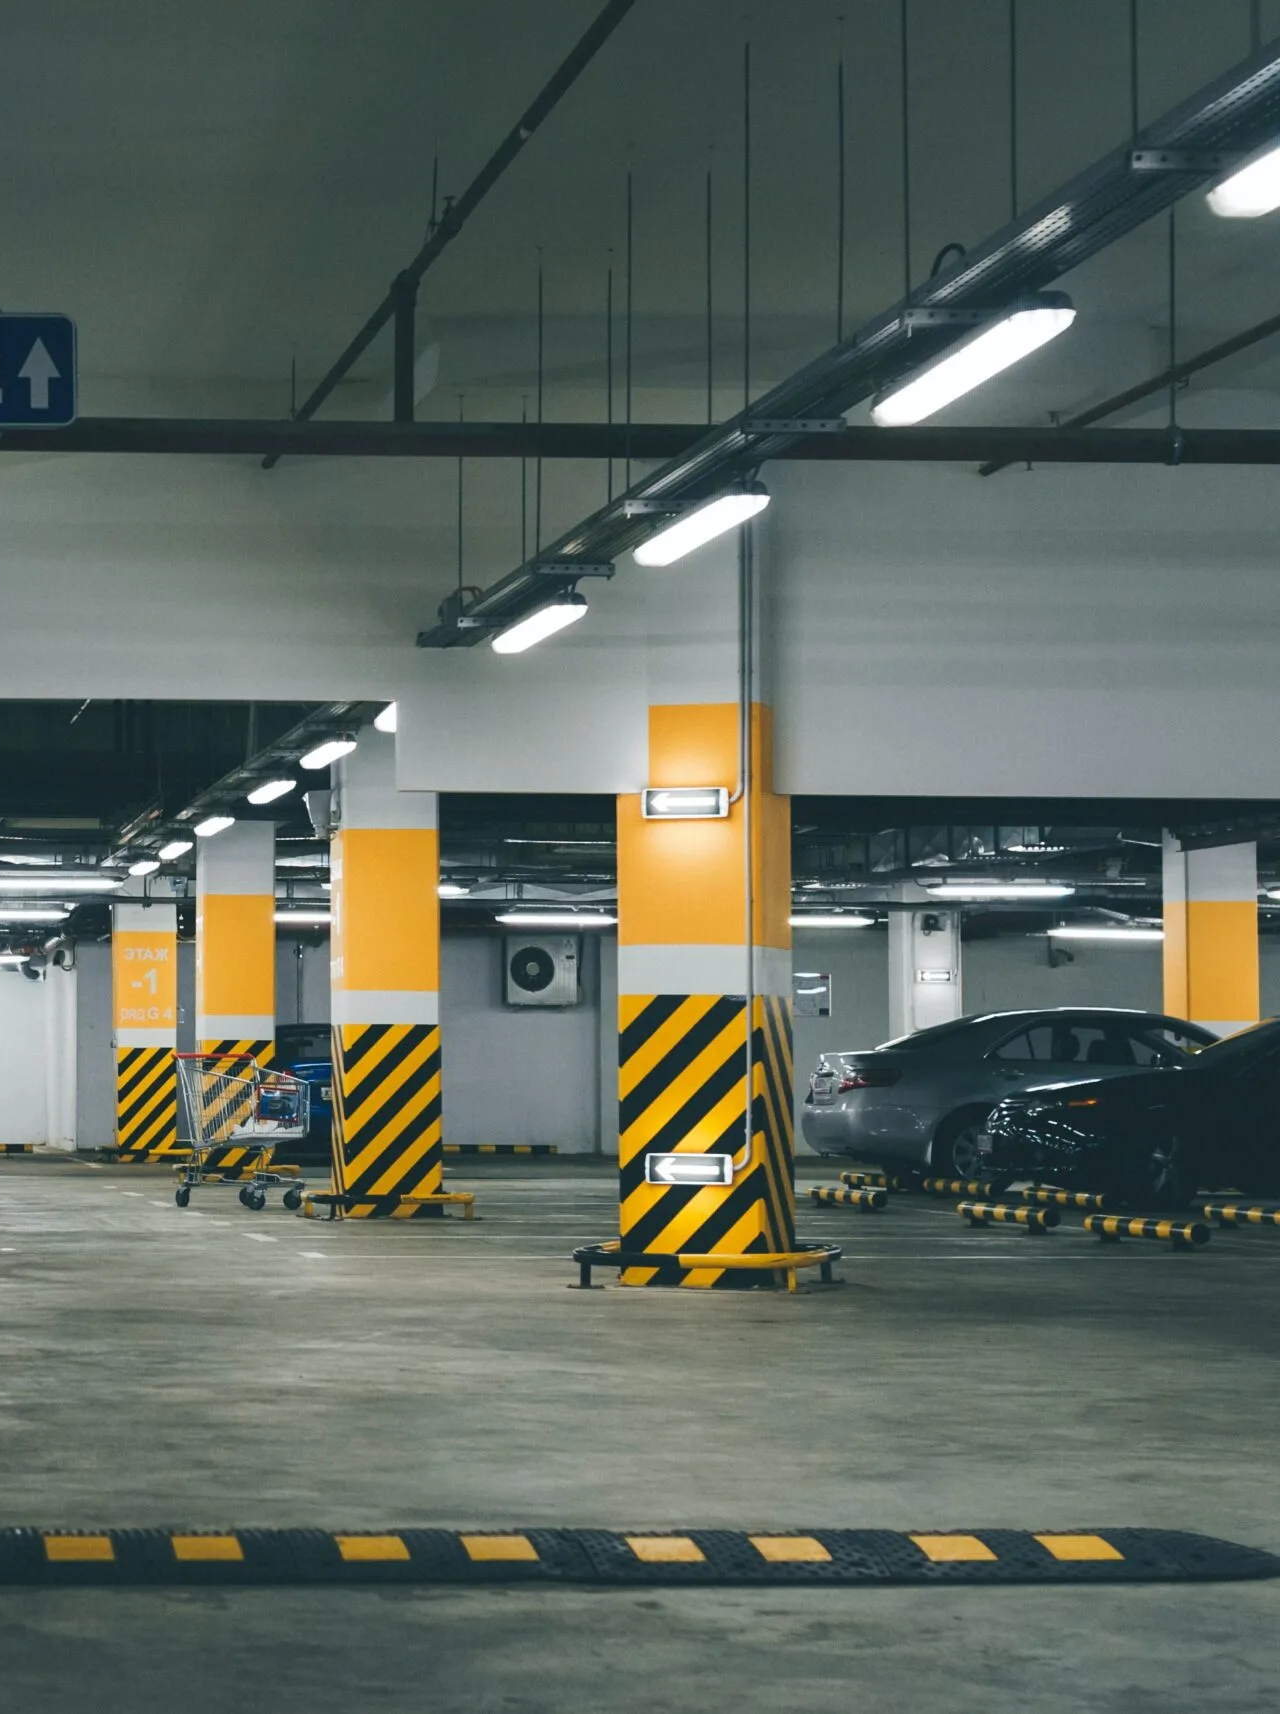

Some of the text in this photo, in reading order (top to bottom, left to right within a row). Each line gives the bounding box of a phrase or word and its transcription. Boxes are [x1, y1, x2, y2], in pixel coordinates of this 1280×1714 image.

[124, 947, 170, 961] ЭТАЖ
[131, 967, 158, 996] -1
[163, 1007, 172, 1020] 4
